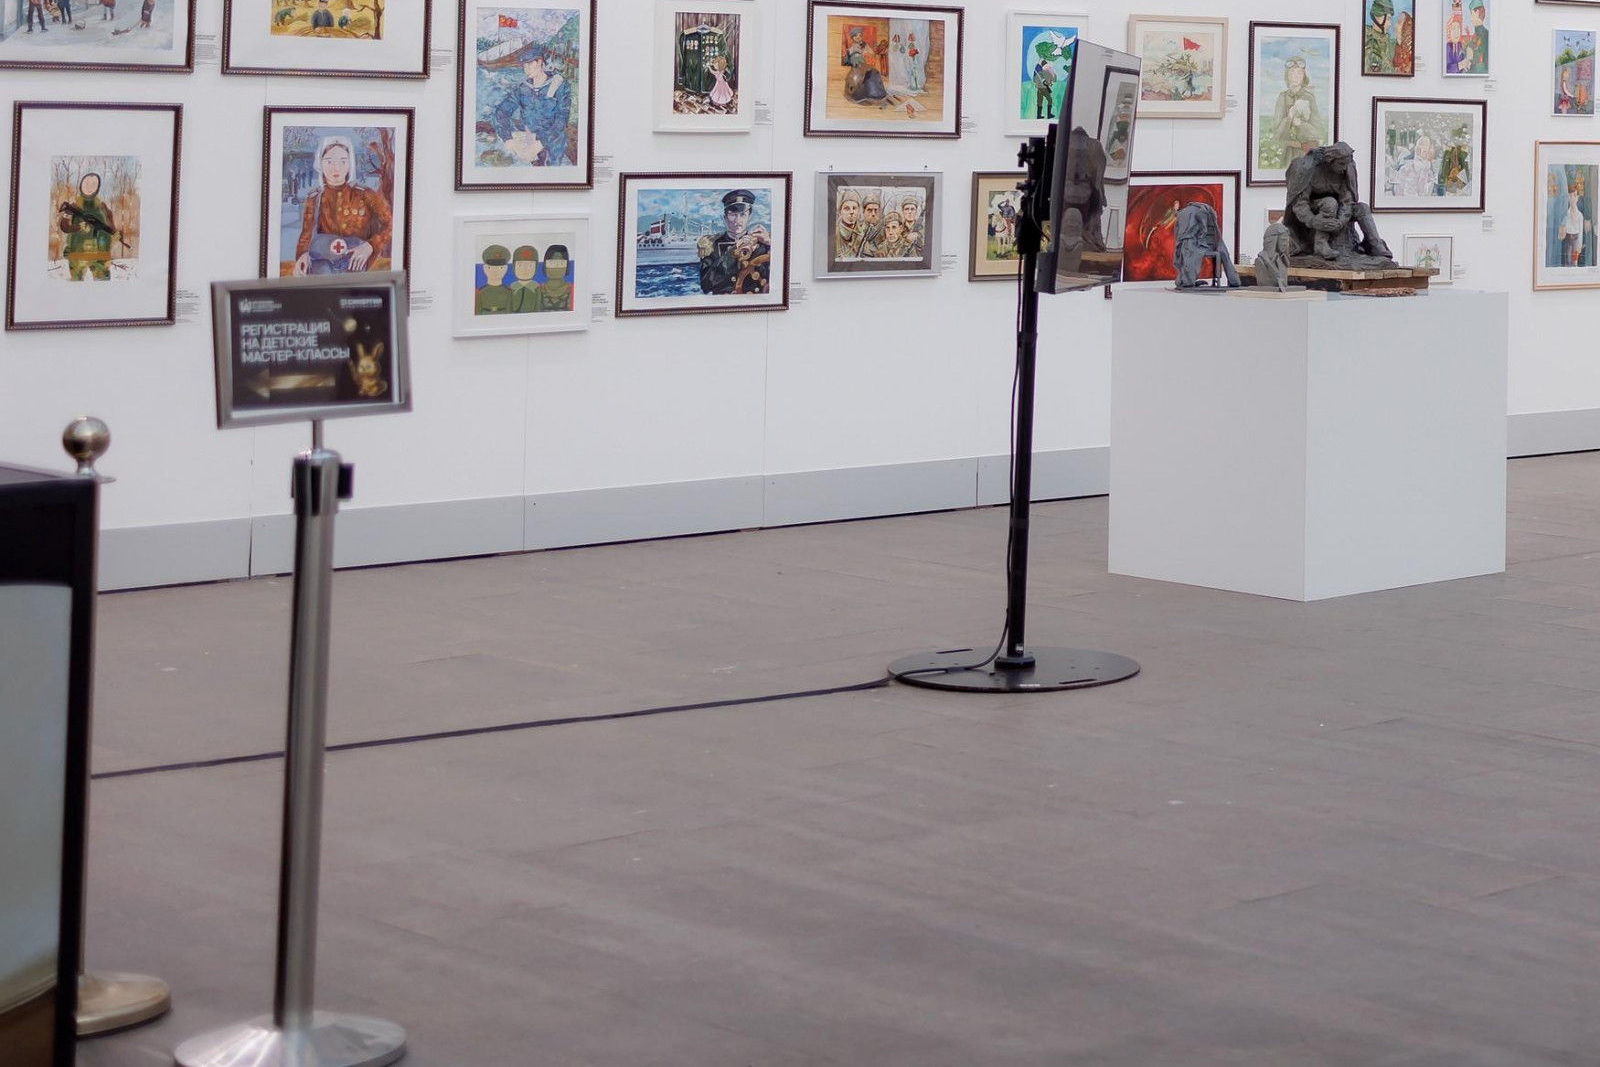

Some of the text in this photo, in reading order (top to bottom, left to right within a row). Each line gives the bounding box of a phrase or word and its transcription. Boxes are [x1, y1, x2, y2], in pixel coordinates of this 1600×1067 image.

[241, 321, 331, 336] РЕГИСТРАЦИЯ
[241, 335, 318, 349] НА ДЕТСКИЕ
[241, 347, 351, 363] МАСТЕР-КЛАССЫ
